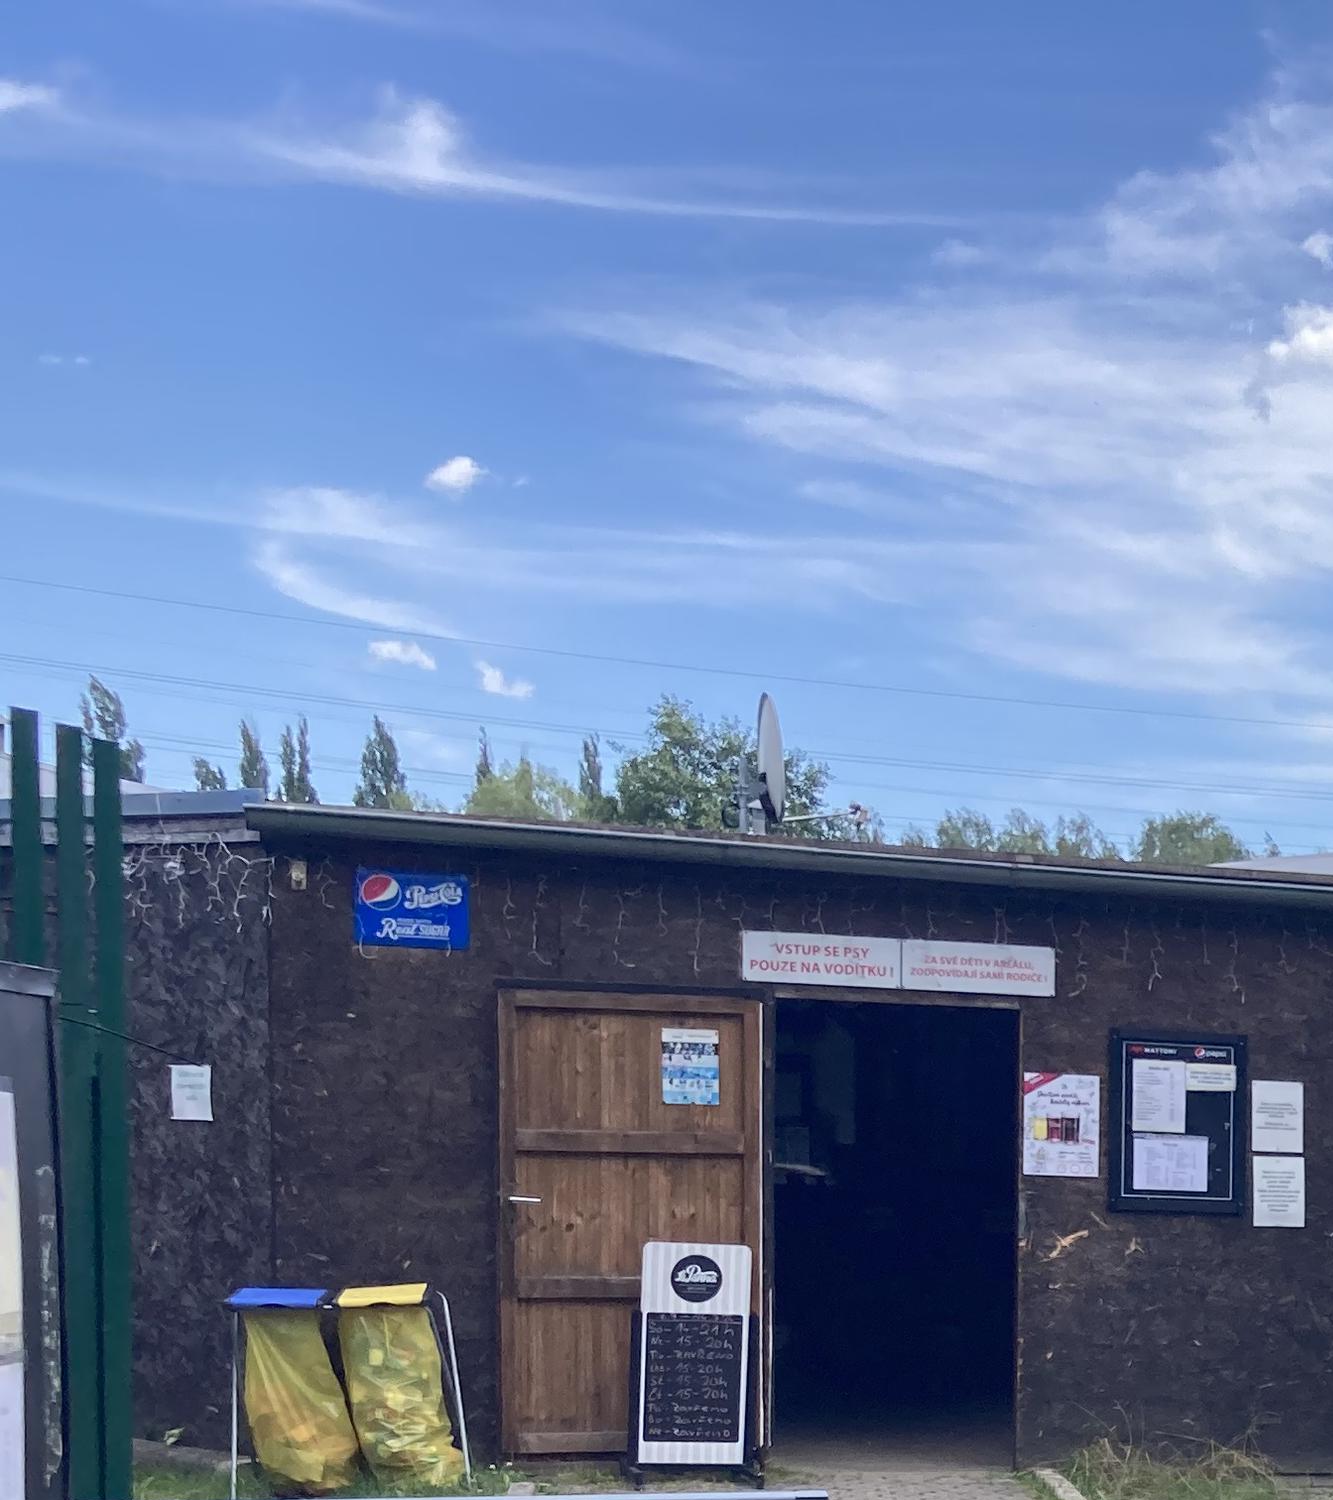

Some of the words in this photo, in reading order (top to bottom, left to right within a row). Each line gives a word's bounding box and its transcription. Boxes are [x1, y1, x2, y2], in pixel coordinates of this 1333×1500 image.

[775, 943, 820, 955] VSTUP
[824, 946, 840, 957] SE
[844, 947, 870, 959] PSY
[750, 959, 797, 973] POUZE
[801, 962, 821, 974] NA
[824, 961, 886, 977] VODÍTKU
